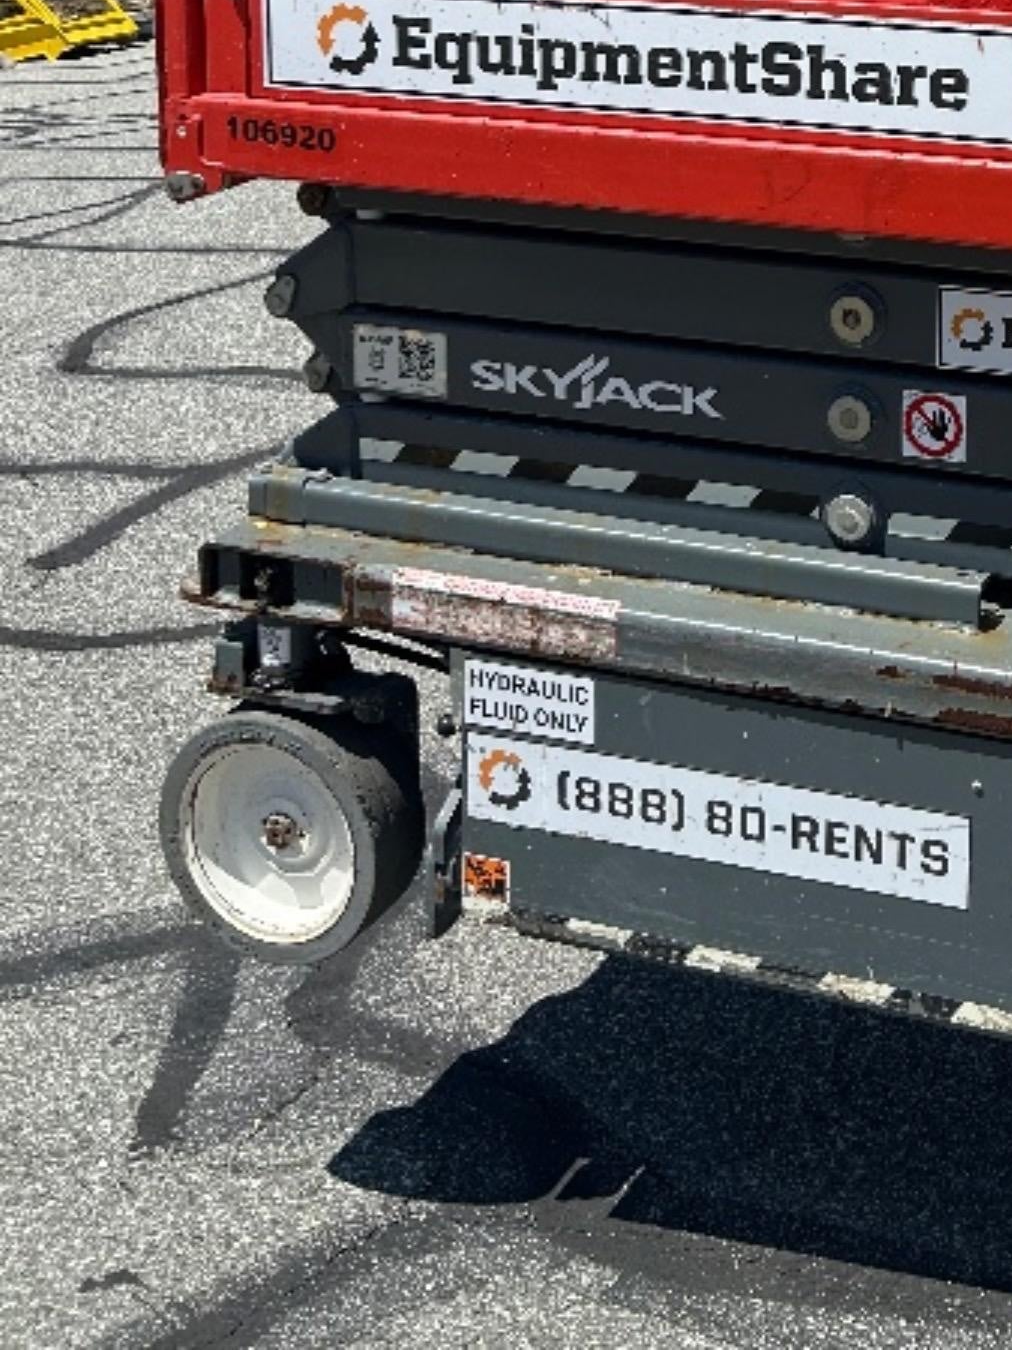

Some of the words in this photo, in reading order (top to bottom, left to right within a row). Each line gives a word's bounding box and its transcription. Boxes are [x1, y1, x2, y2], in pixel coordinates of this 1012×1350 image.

[392, 15, 968, 111] EquipmentShare
[225, 113, 336, 154] 106920
[470, 353, 723, 418] SKYJACK
[469, 668, 589, 706] HYDRAULIC
[469, 697, 529, 724] FLUID
[533, 708, 588, 733] ONLY
[556, 770, 687, 832] (888)
[705, 800, 950, 876] 80-RENTS
